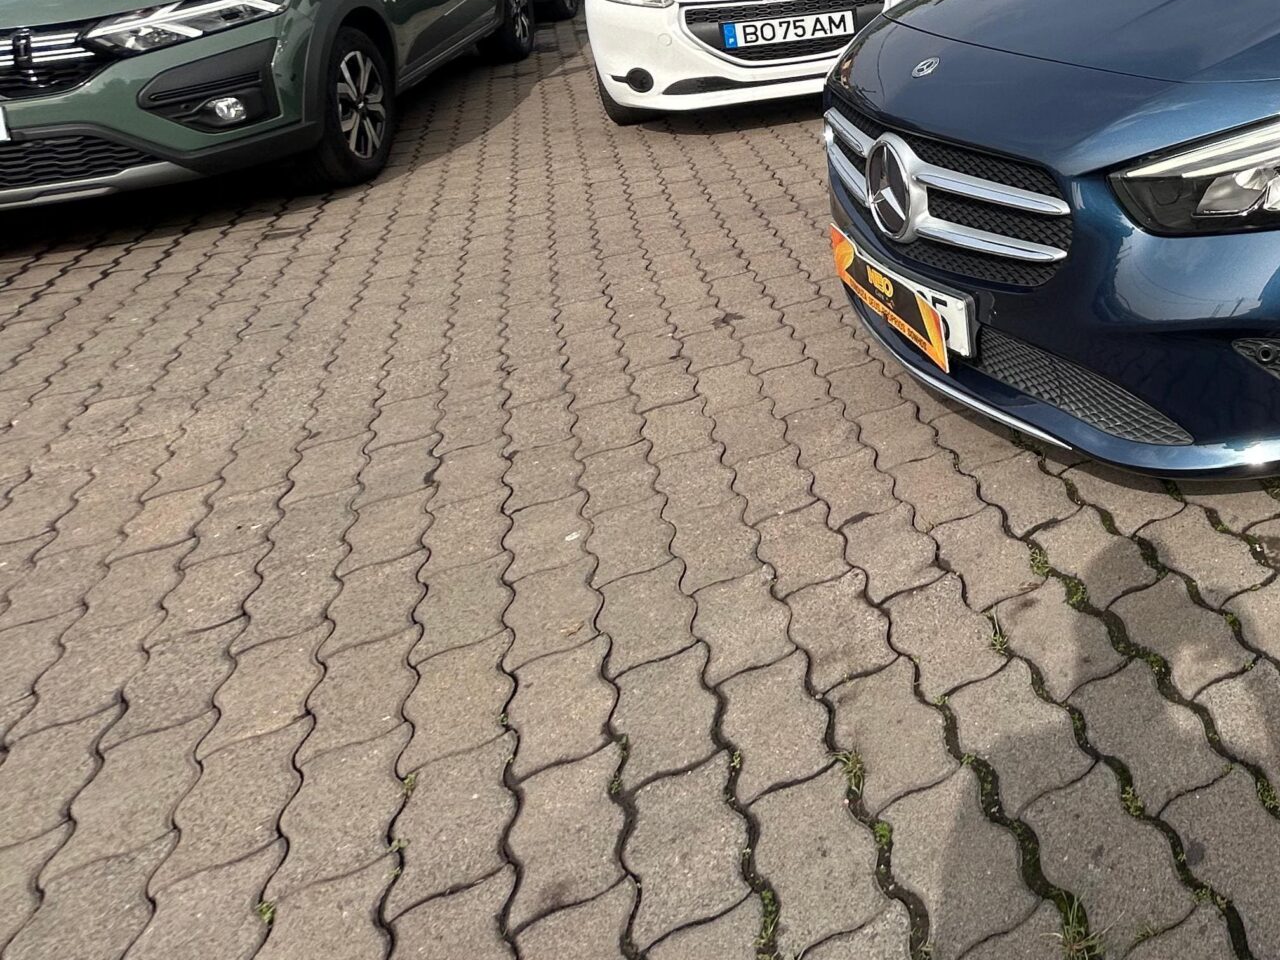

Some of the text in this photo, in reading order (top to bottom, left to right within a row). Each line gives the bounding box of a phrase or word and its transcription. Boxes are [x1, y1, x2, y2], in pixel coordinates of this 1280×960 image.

[742, 23, 776, 44] BO
[779, 19, 806, 40] 75
[811, 14, 847, 36] AM
[867, 265, 894, 298] NEO
